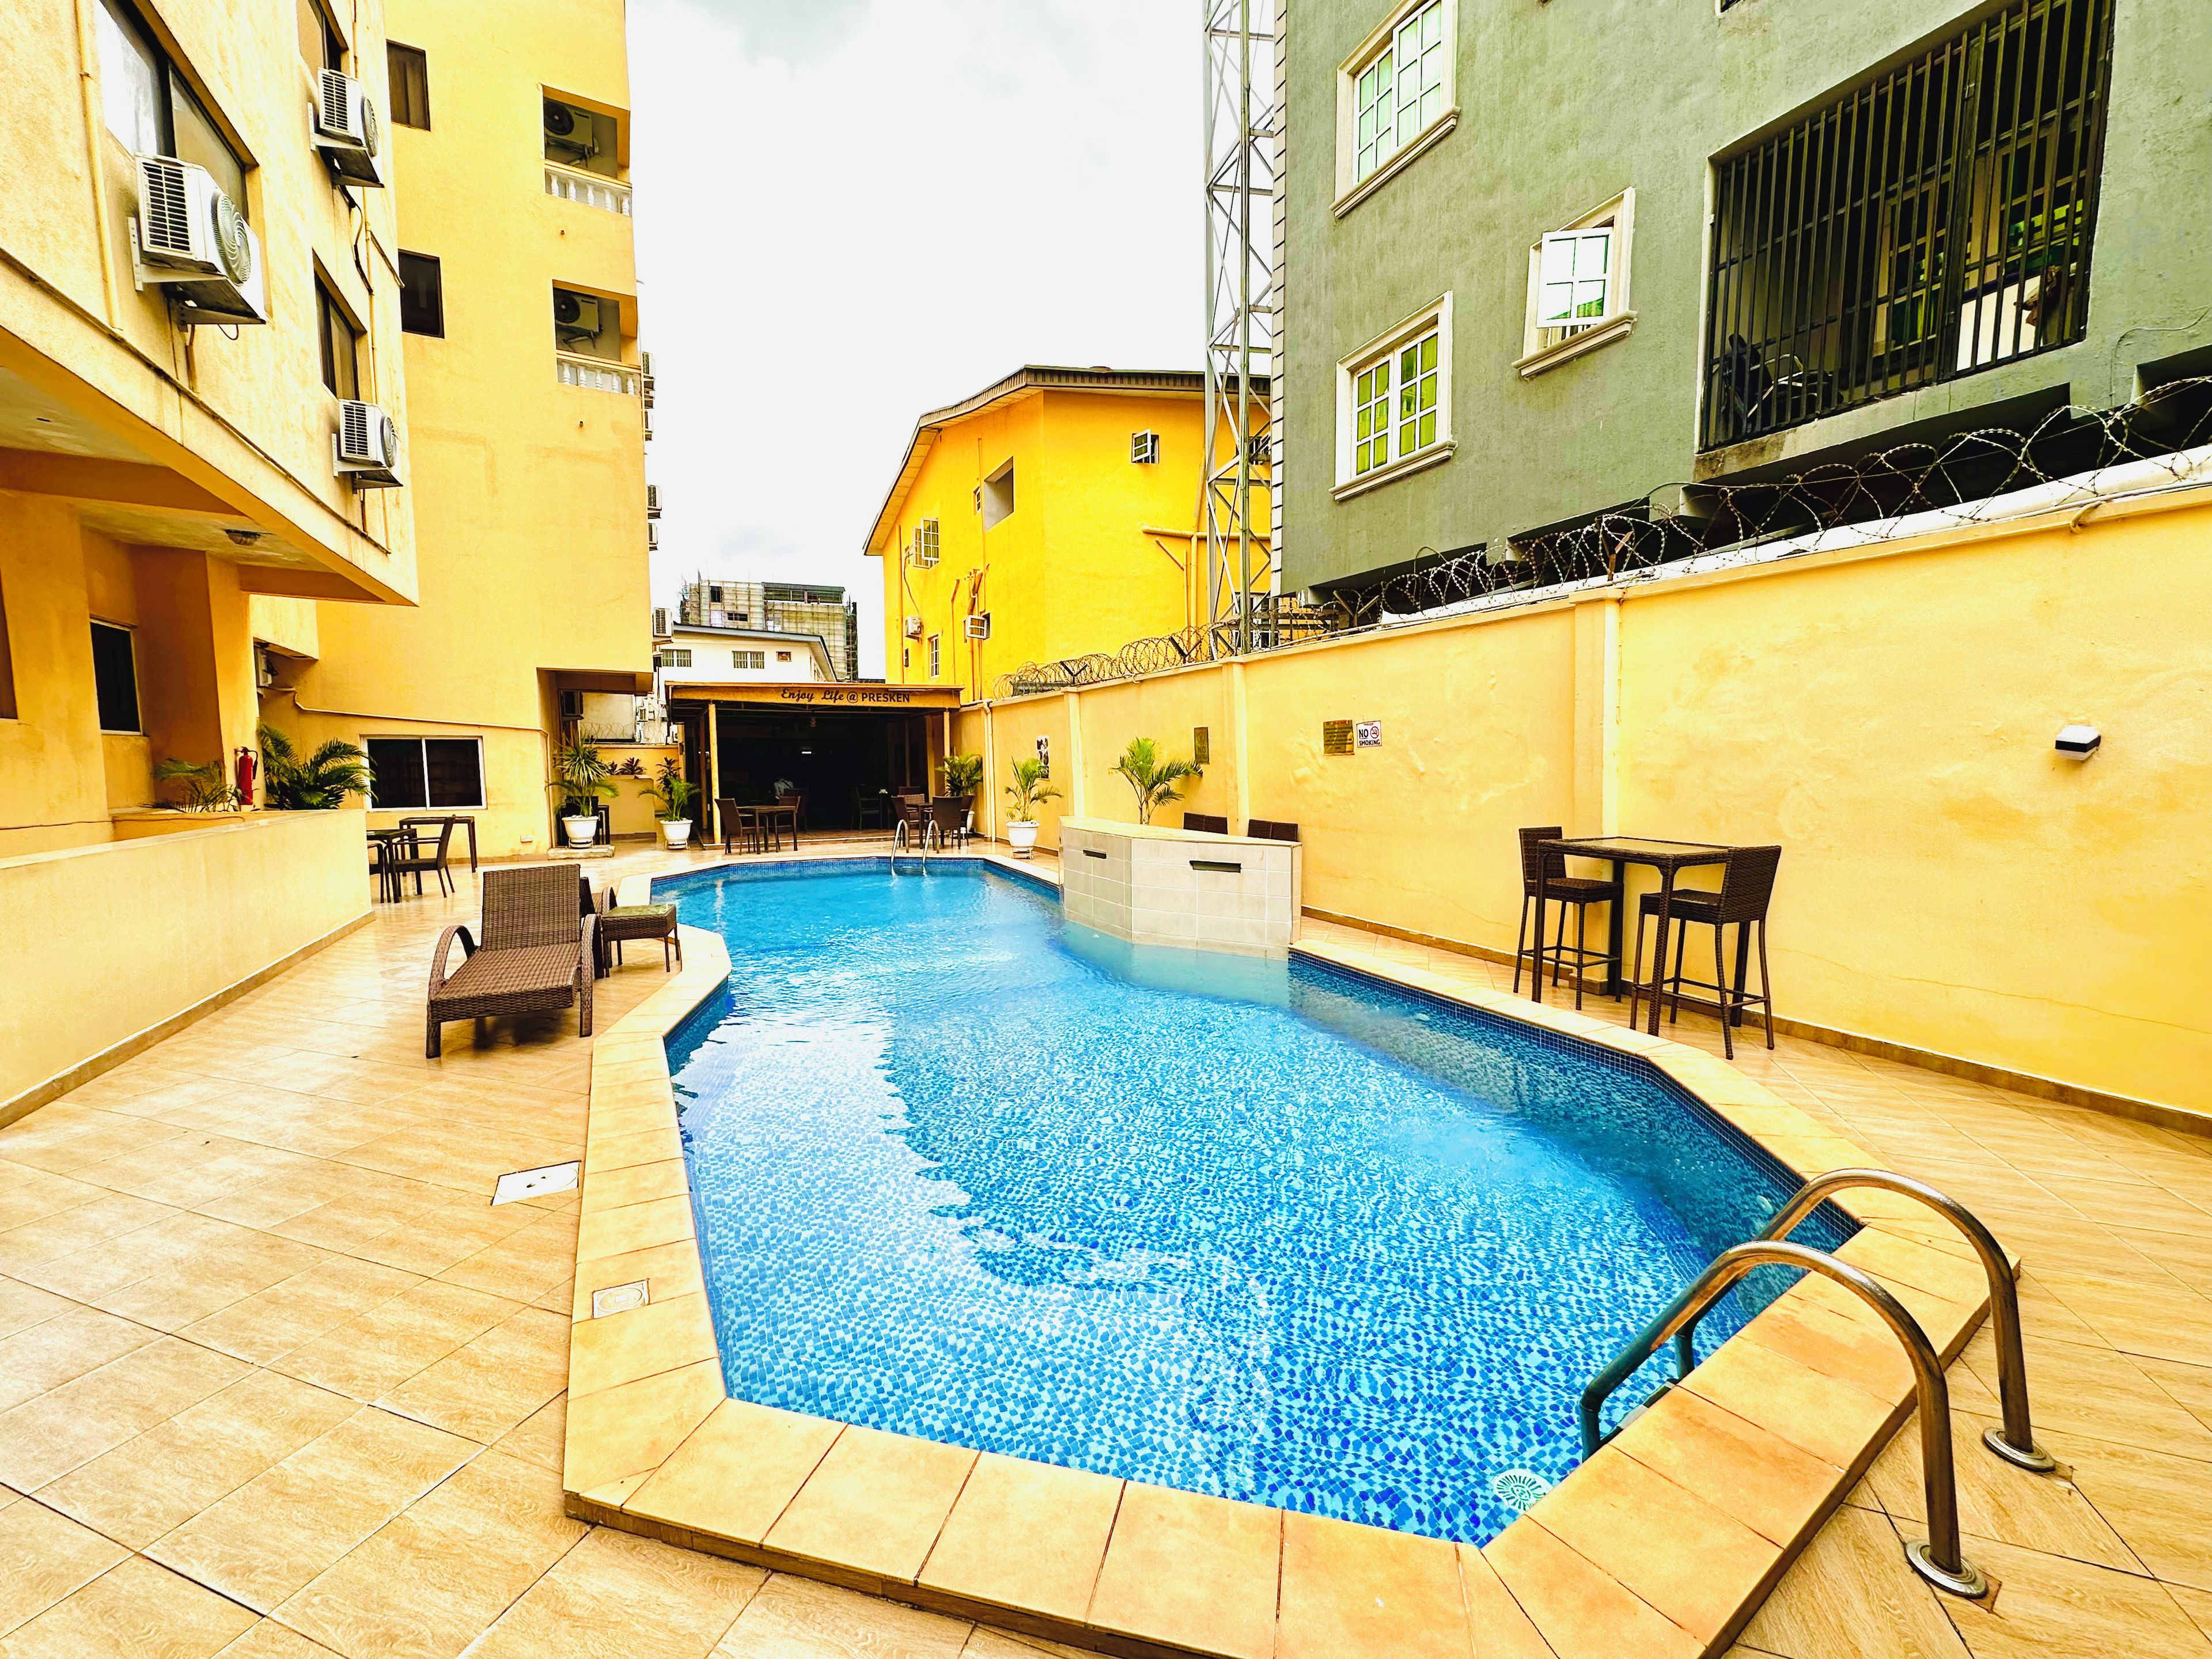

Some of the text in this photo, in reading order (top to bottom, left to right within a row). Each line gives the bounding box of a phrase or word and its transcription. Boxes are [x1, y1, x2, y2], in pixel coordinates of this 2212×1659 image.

[781, 689, 910, 703] Enjoy Life @ PRESKEN
[1359, 729, 1369, 738] NO
